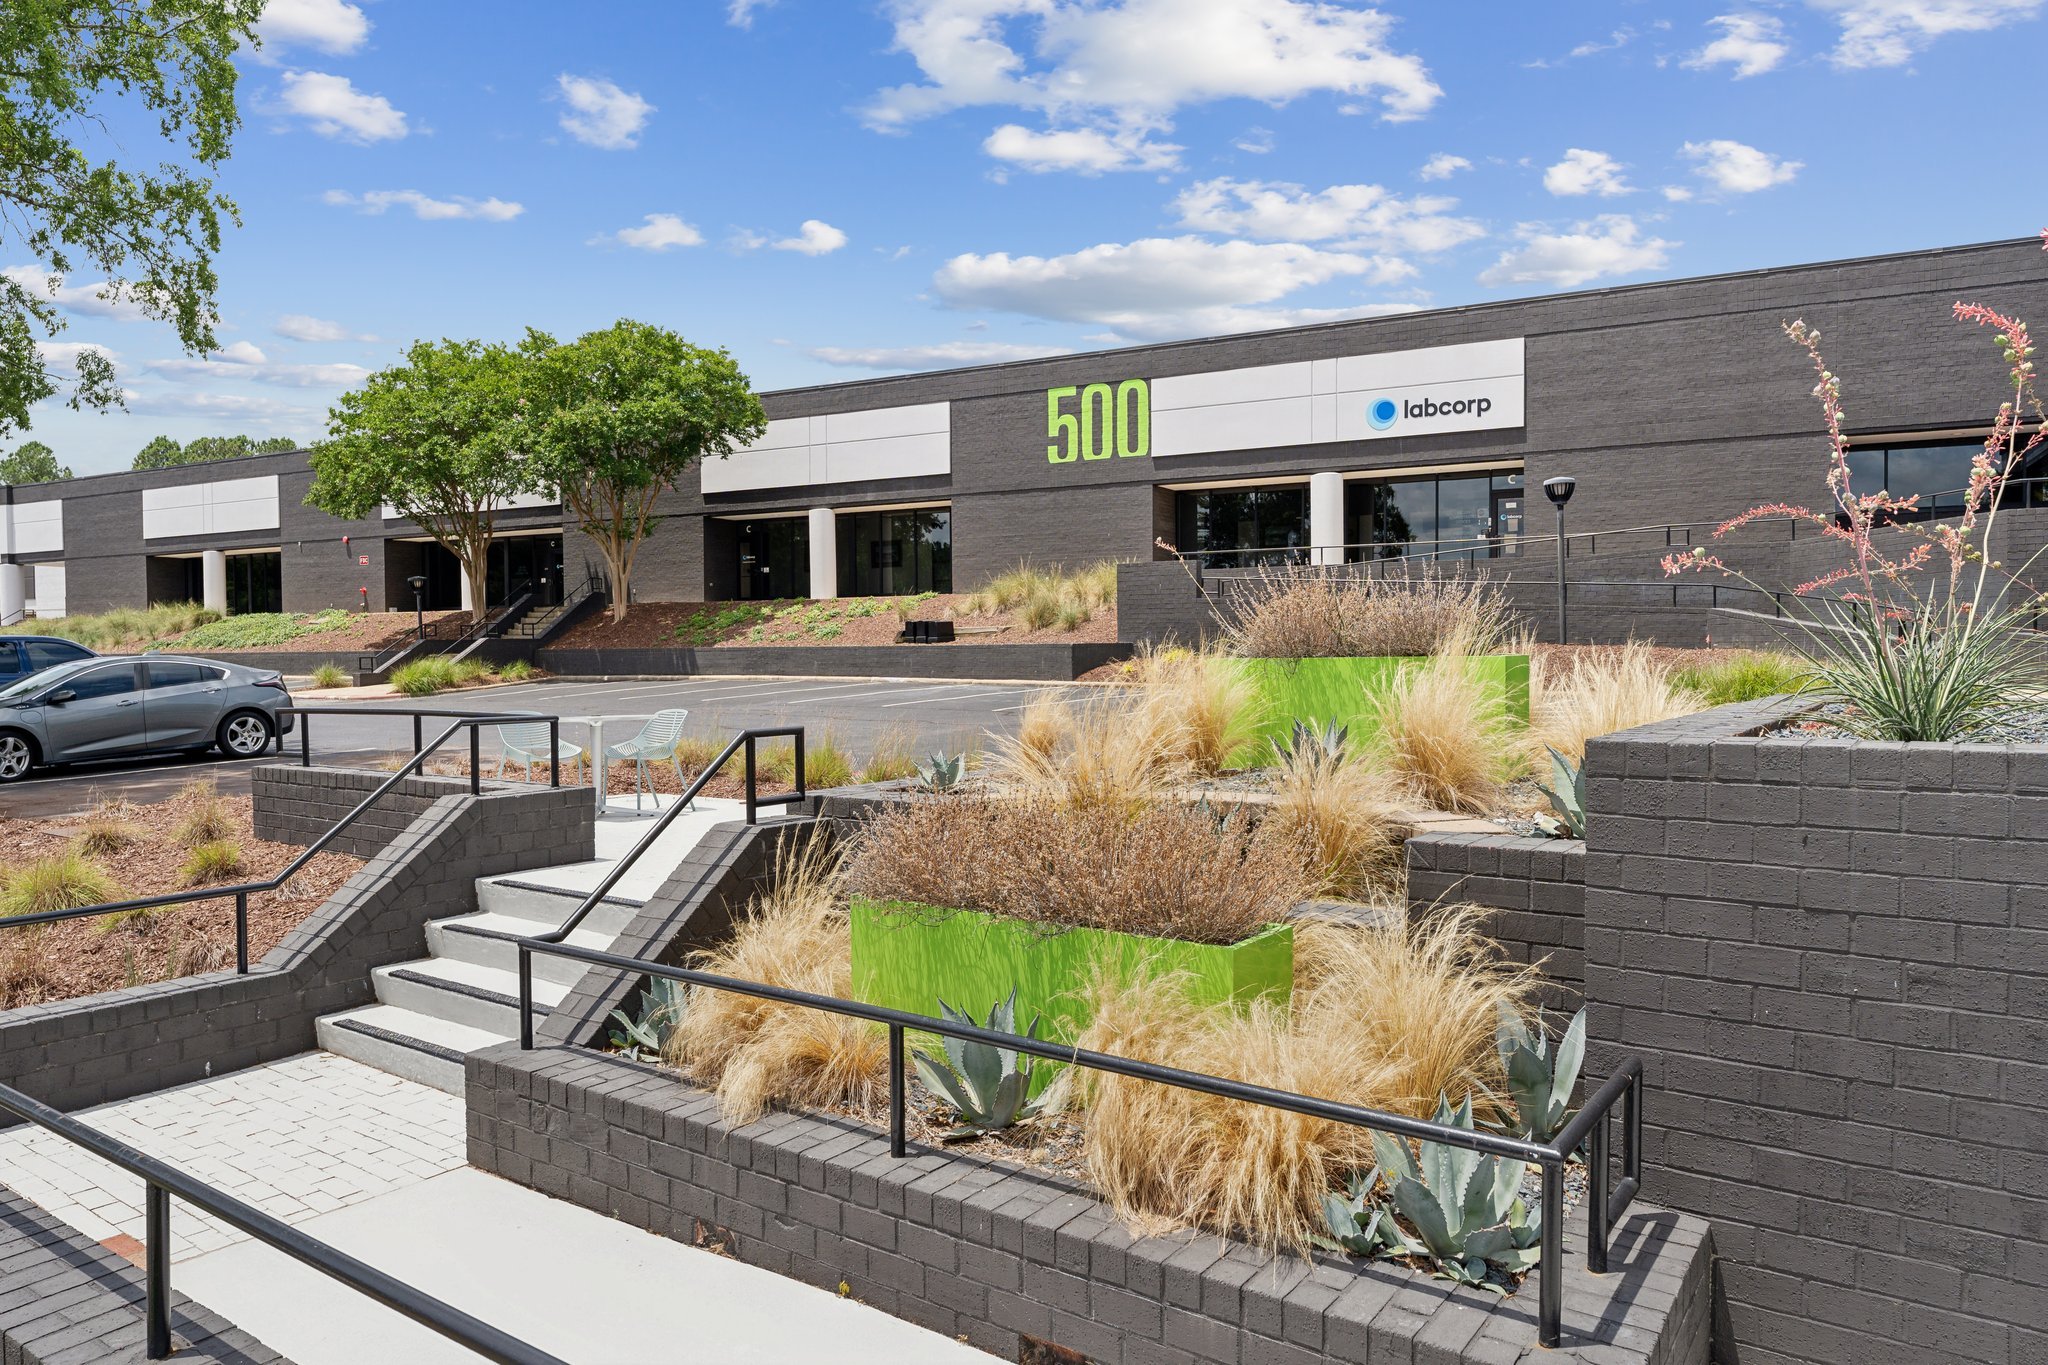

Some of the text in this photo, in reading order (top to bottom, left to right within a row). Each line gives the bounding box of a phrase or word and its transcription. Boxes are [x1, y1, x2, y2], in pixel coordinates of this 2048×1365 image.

[1403, 397, 1492, 419] labcorp
[1047, 378, 1149, 464] 500
[1507, 474, 1516, 484] C
[746, 525, 752, 533] C
